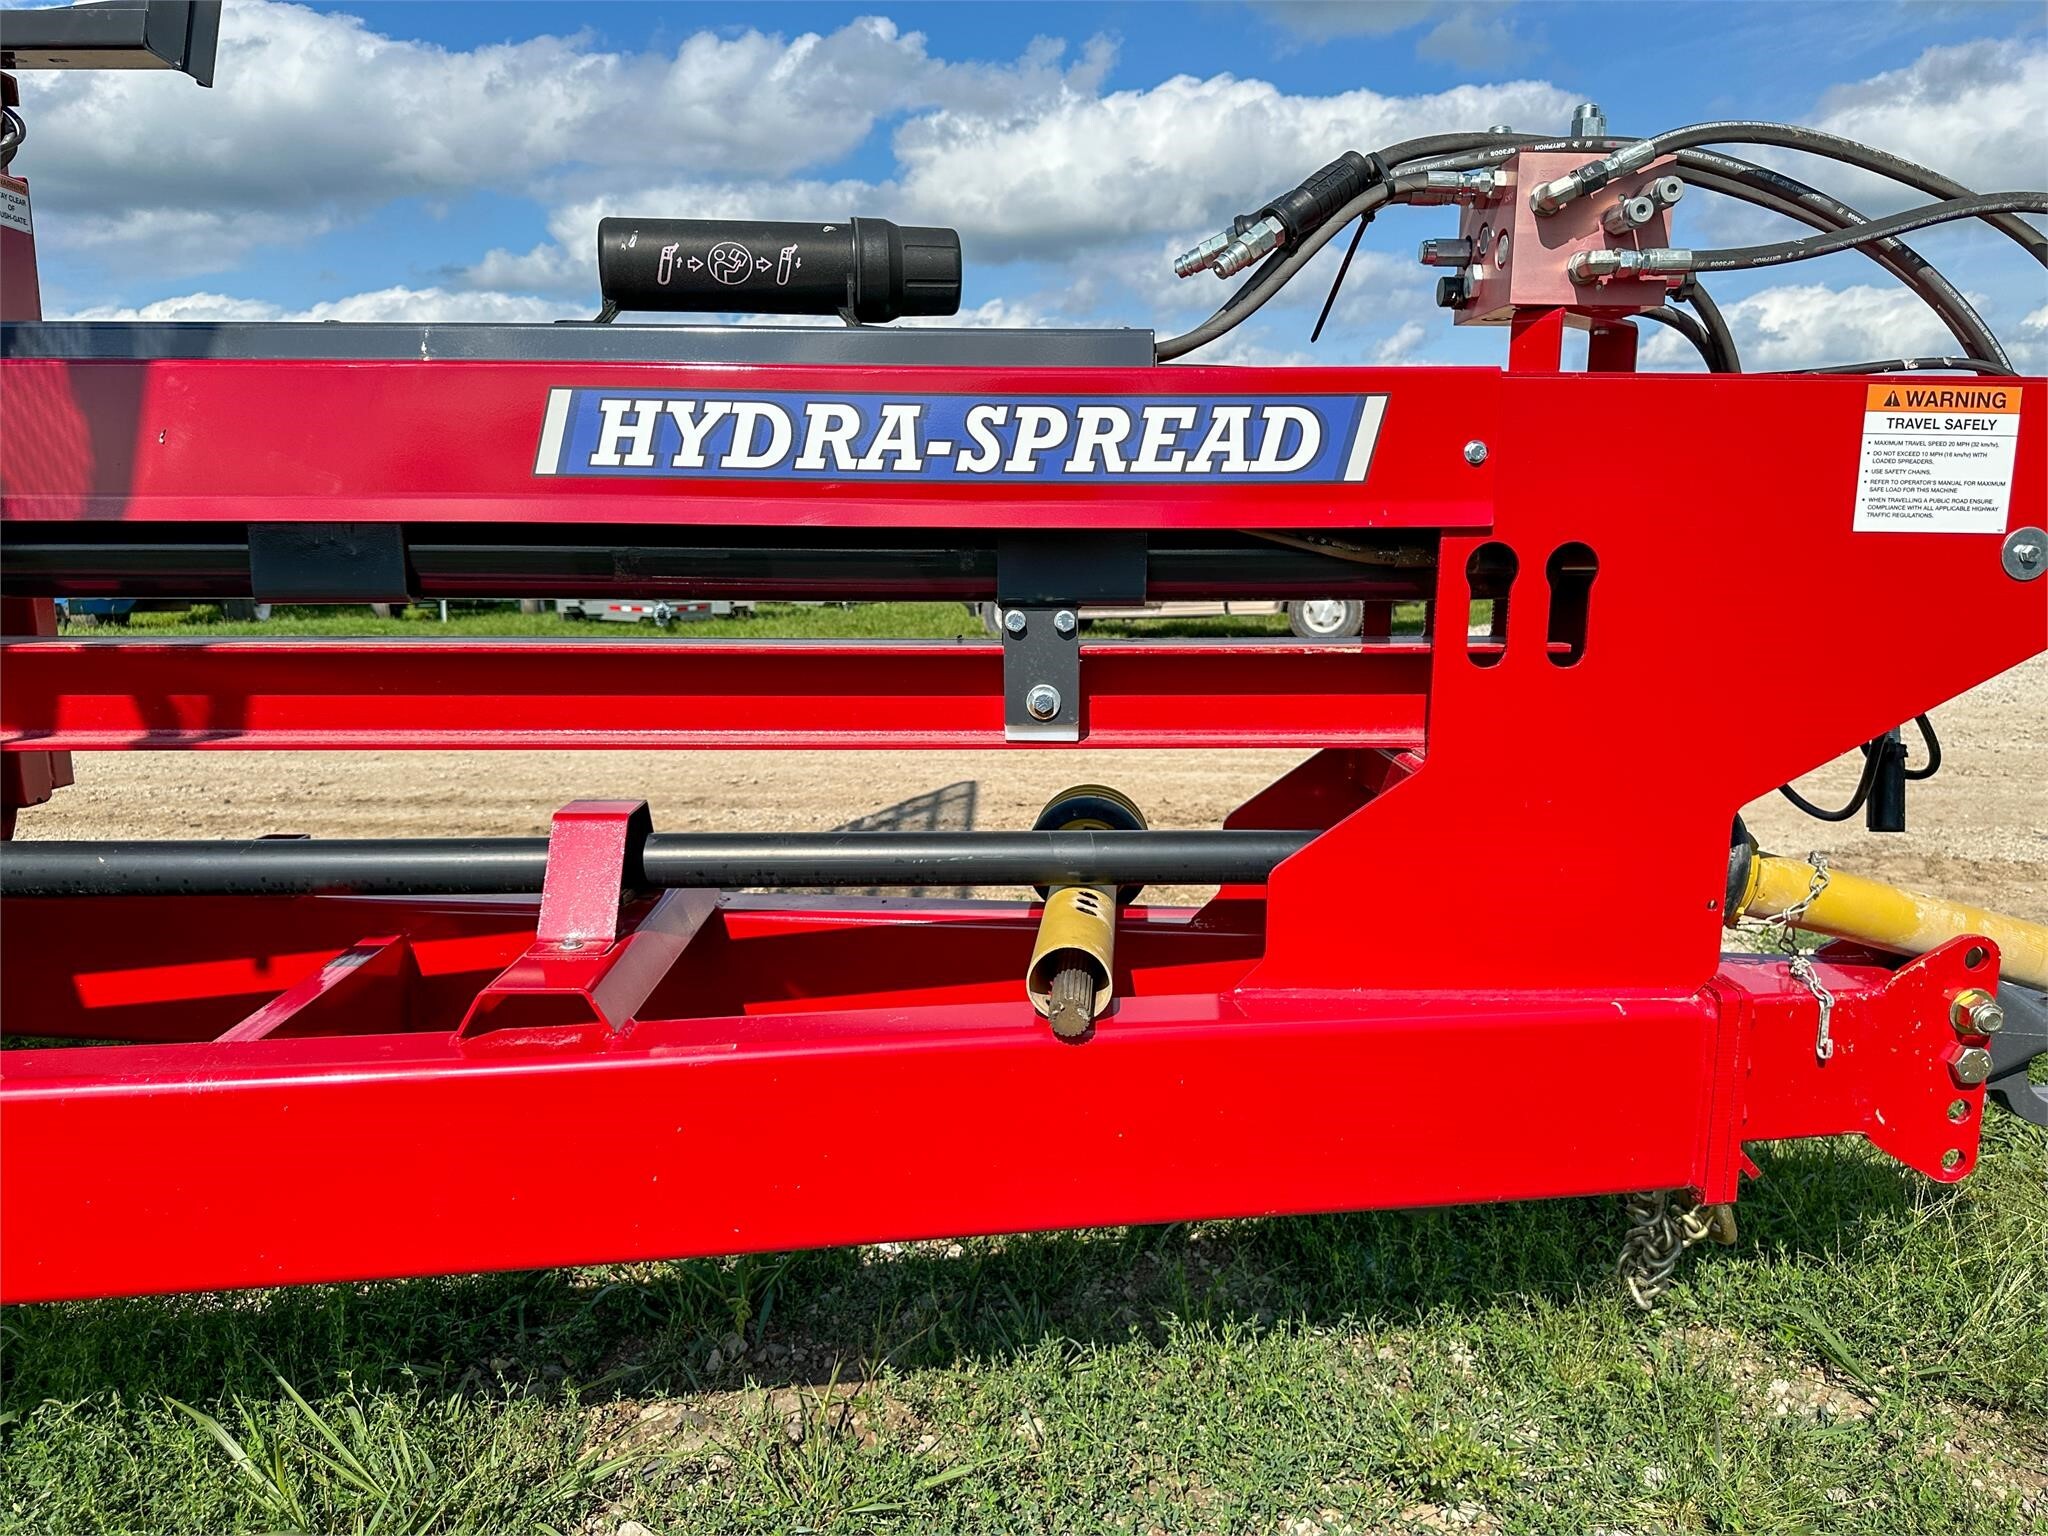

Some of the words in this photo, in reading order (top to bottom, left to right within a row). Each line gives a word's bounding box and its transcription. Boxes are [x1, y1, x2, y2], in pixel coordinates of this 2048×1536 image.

[1534, 141, 1566, 151] GRYPHON
[1674, 148, 1704, 159] RESISTAN
[7, 203, 15, 212] OF
[1906, 390, 2007, 409] WARNING
[1886, 417, 1940, 430] TRAVEL
[1944, 418, 1997, 431] SAFELY
[588, 399, 1322, 474] HYDRA-SPREAD
